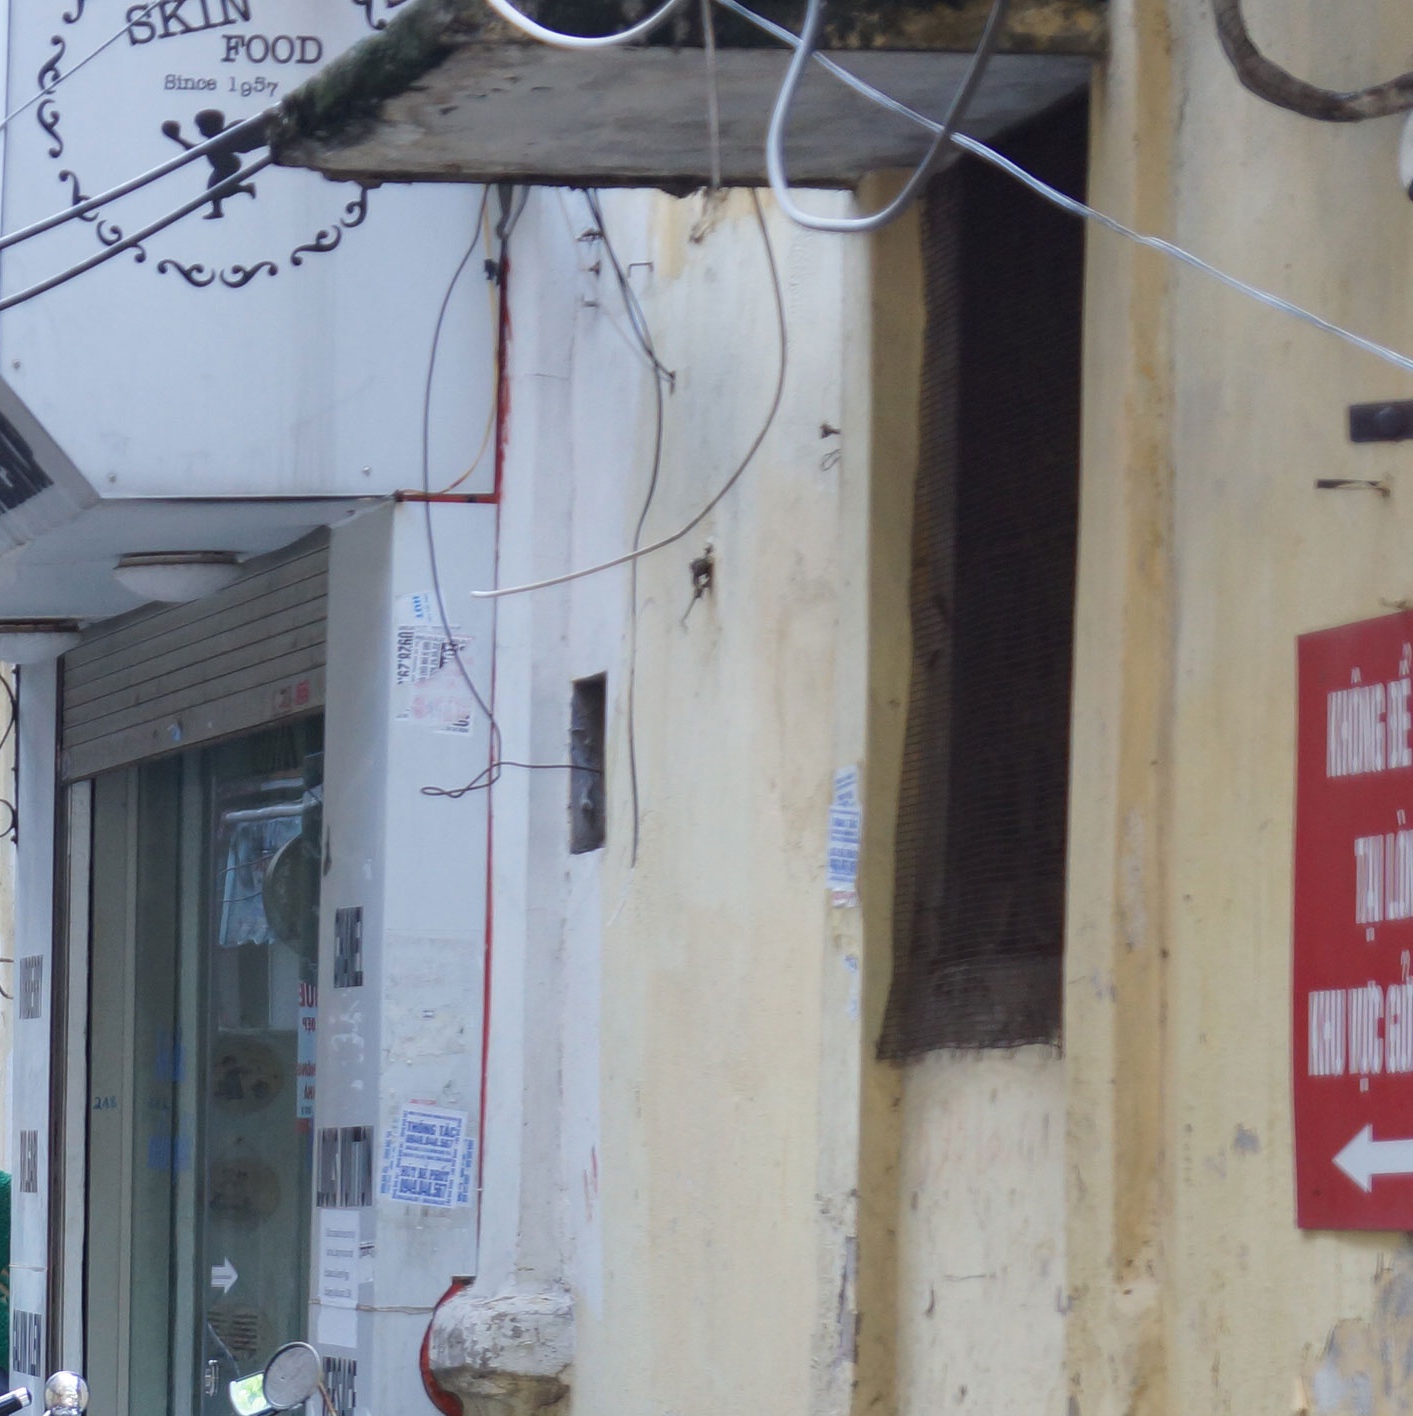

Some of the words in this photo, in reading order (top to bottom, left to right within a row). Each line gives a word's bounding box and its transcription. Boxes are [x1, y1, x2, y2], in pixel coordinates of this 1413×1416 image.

[164, 74, 217, 91] Since
[228, 76, 278, 97] 1957
[221, 34, 323, 64] FOOD
[1326, 667, 1386, 777] KHÔNG
[1387, 643, 1413, 768] ĐỂ
[1354, 834, 1384, 941] TẠI
[1308, 988, 1347, 1077] KHU
[1348, 980, 1383, 1093] VỰC
